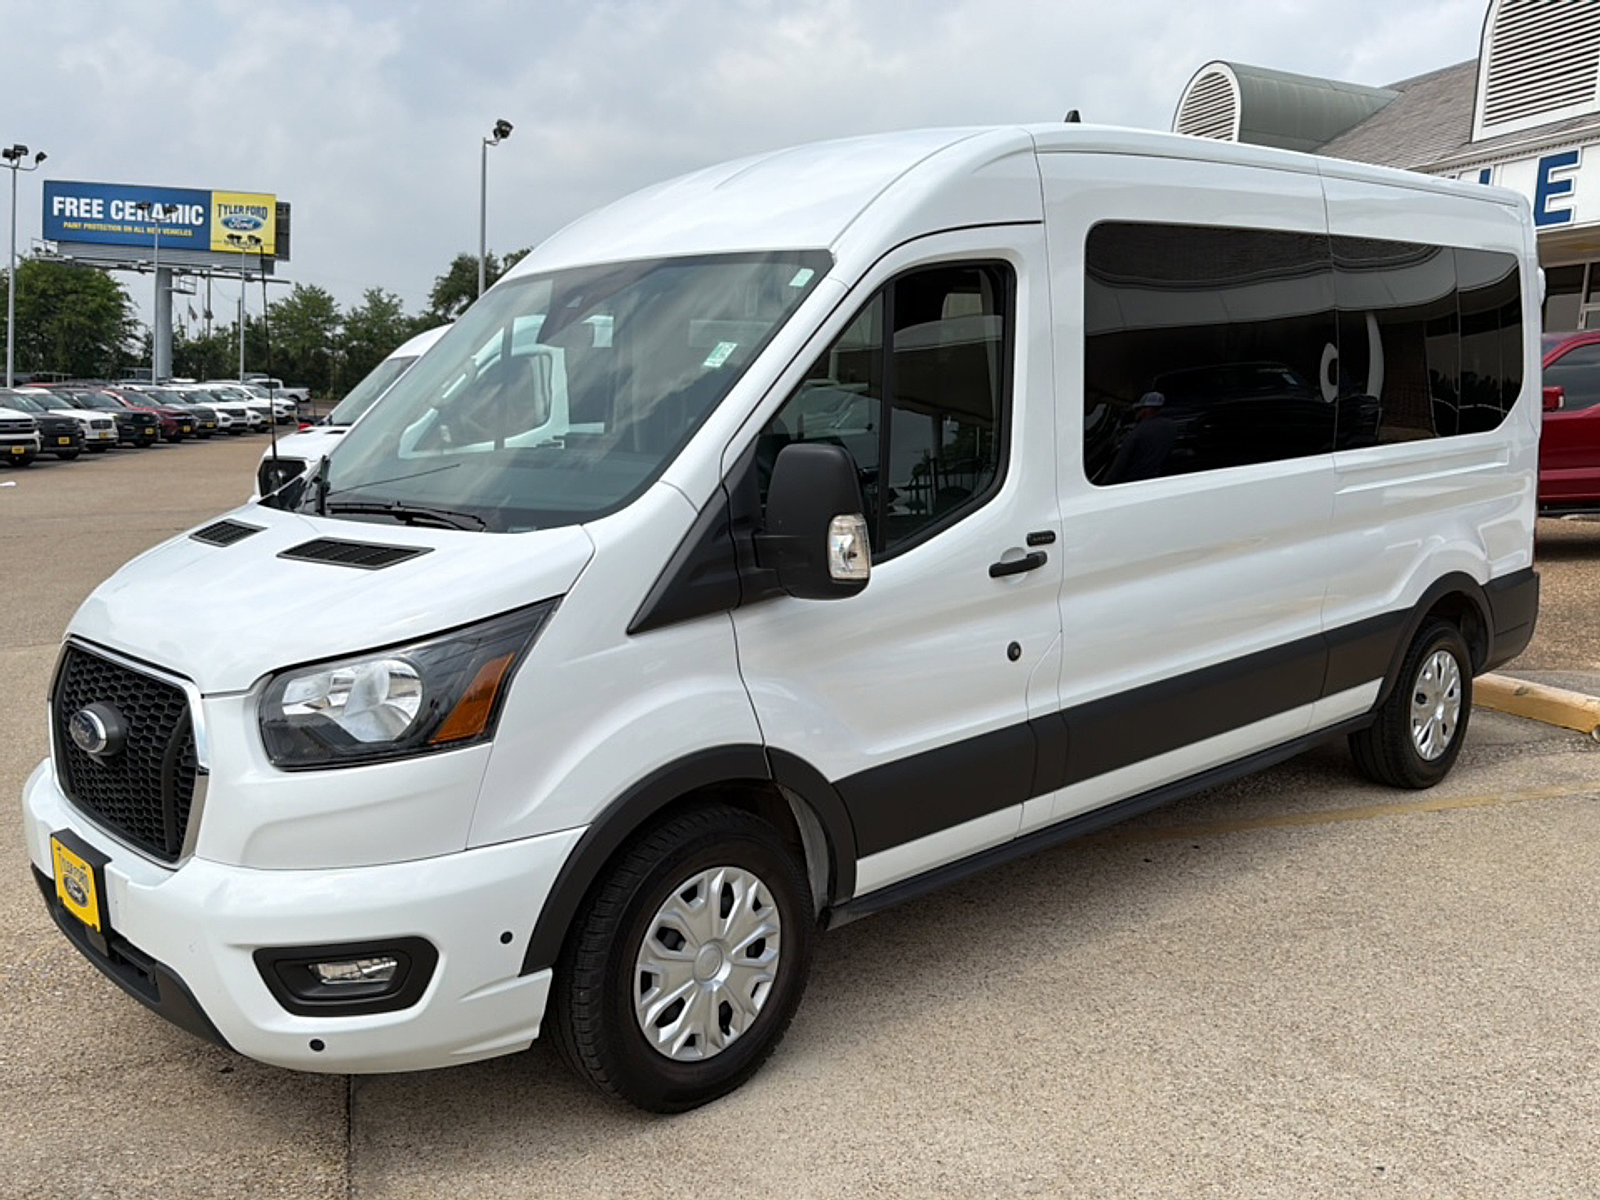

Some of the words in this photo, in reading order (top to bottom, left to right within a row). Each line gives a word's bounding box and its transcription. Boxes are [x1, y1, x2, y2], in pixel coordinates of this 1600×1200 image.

[53, 196, 104, 218] FREE
[110, 200, 204, 225] CERAMIC
[217, 203, 245, 218] TYLER
[245, 205, 268, 220] FORD
[63, 221, 81, 230] PAINT
[83, 223, 121, 232] PROTECTION
[162, 228, 193, 237] VEHICLES
